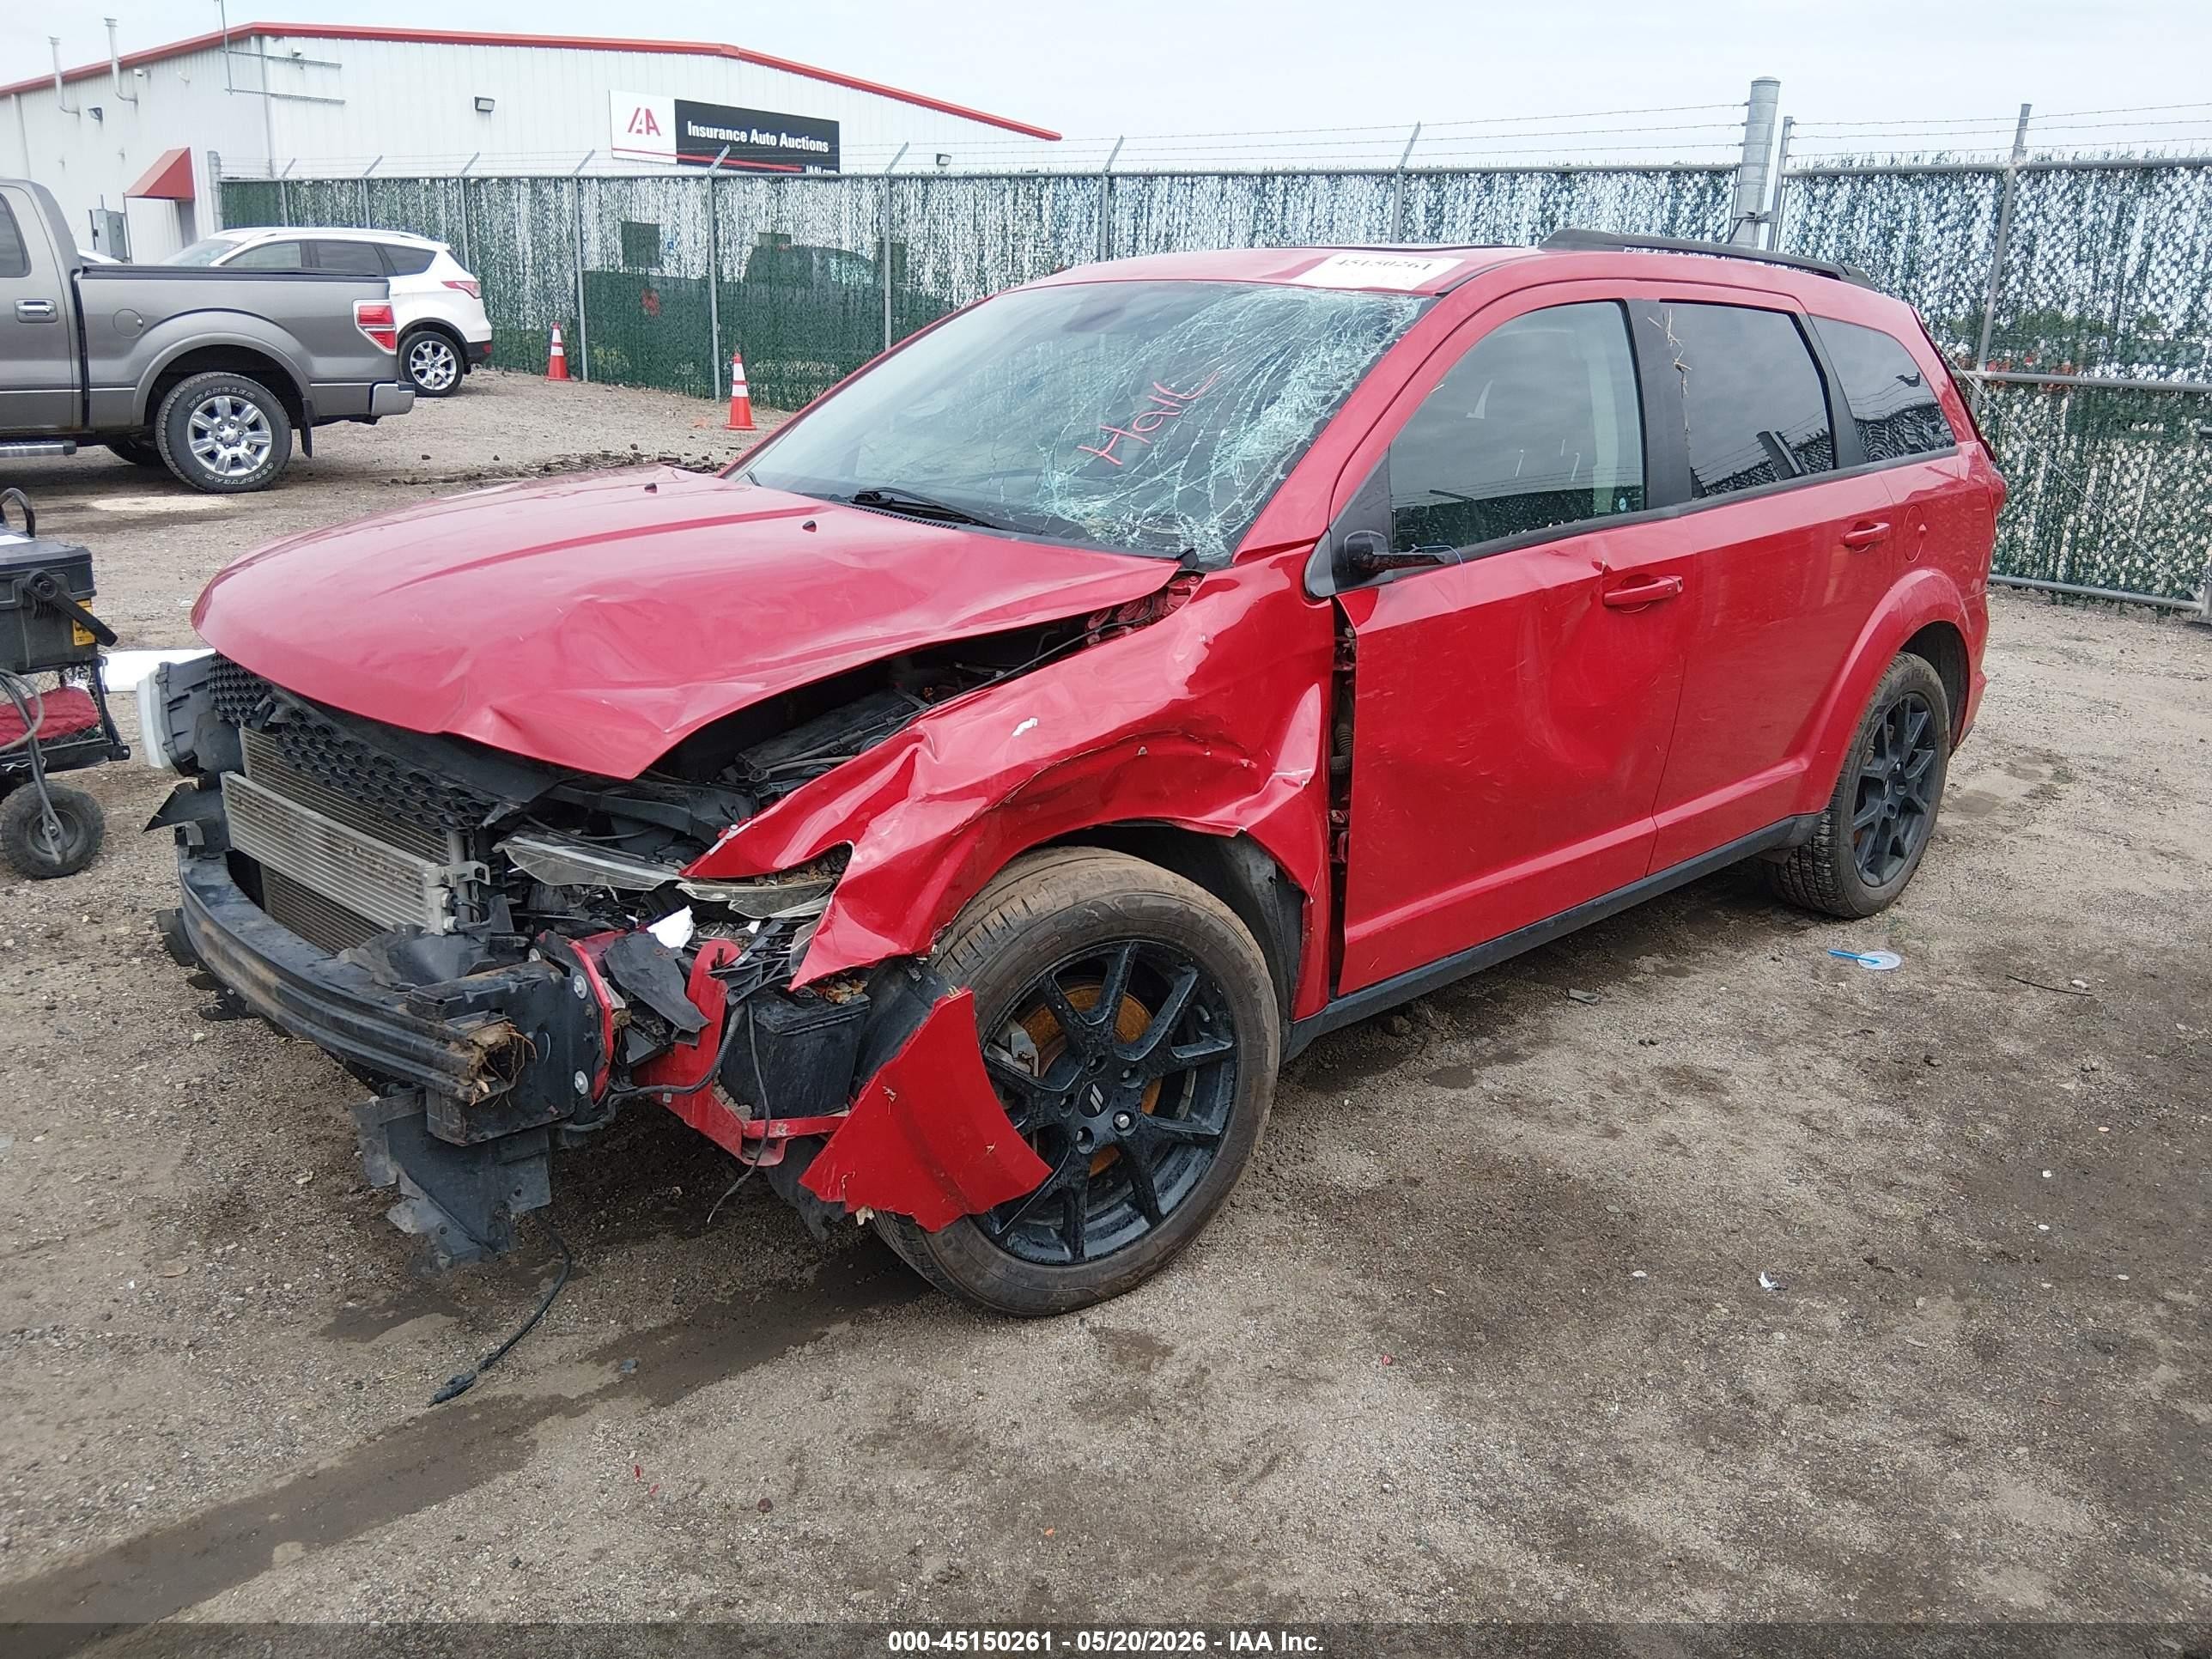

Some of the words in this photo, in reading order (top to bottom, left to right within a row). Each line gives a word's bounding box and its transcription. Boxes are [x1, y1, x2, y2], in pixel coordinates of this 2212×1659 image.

[687, 120, 748, 143] Insurance
[750, 129, 777, 146] Auto
[779, 132, 830, 153] Auctions
